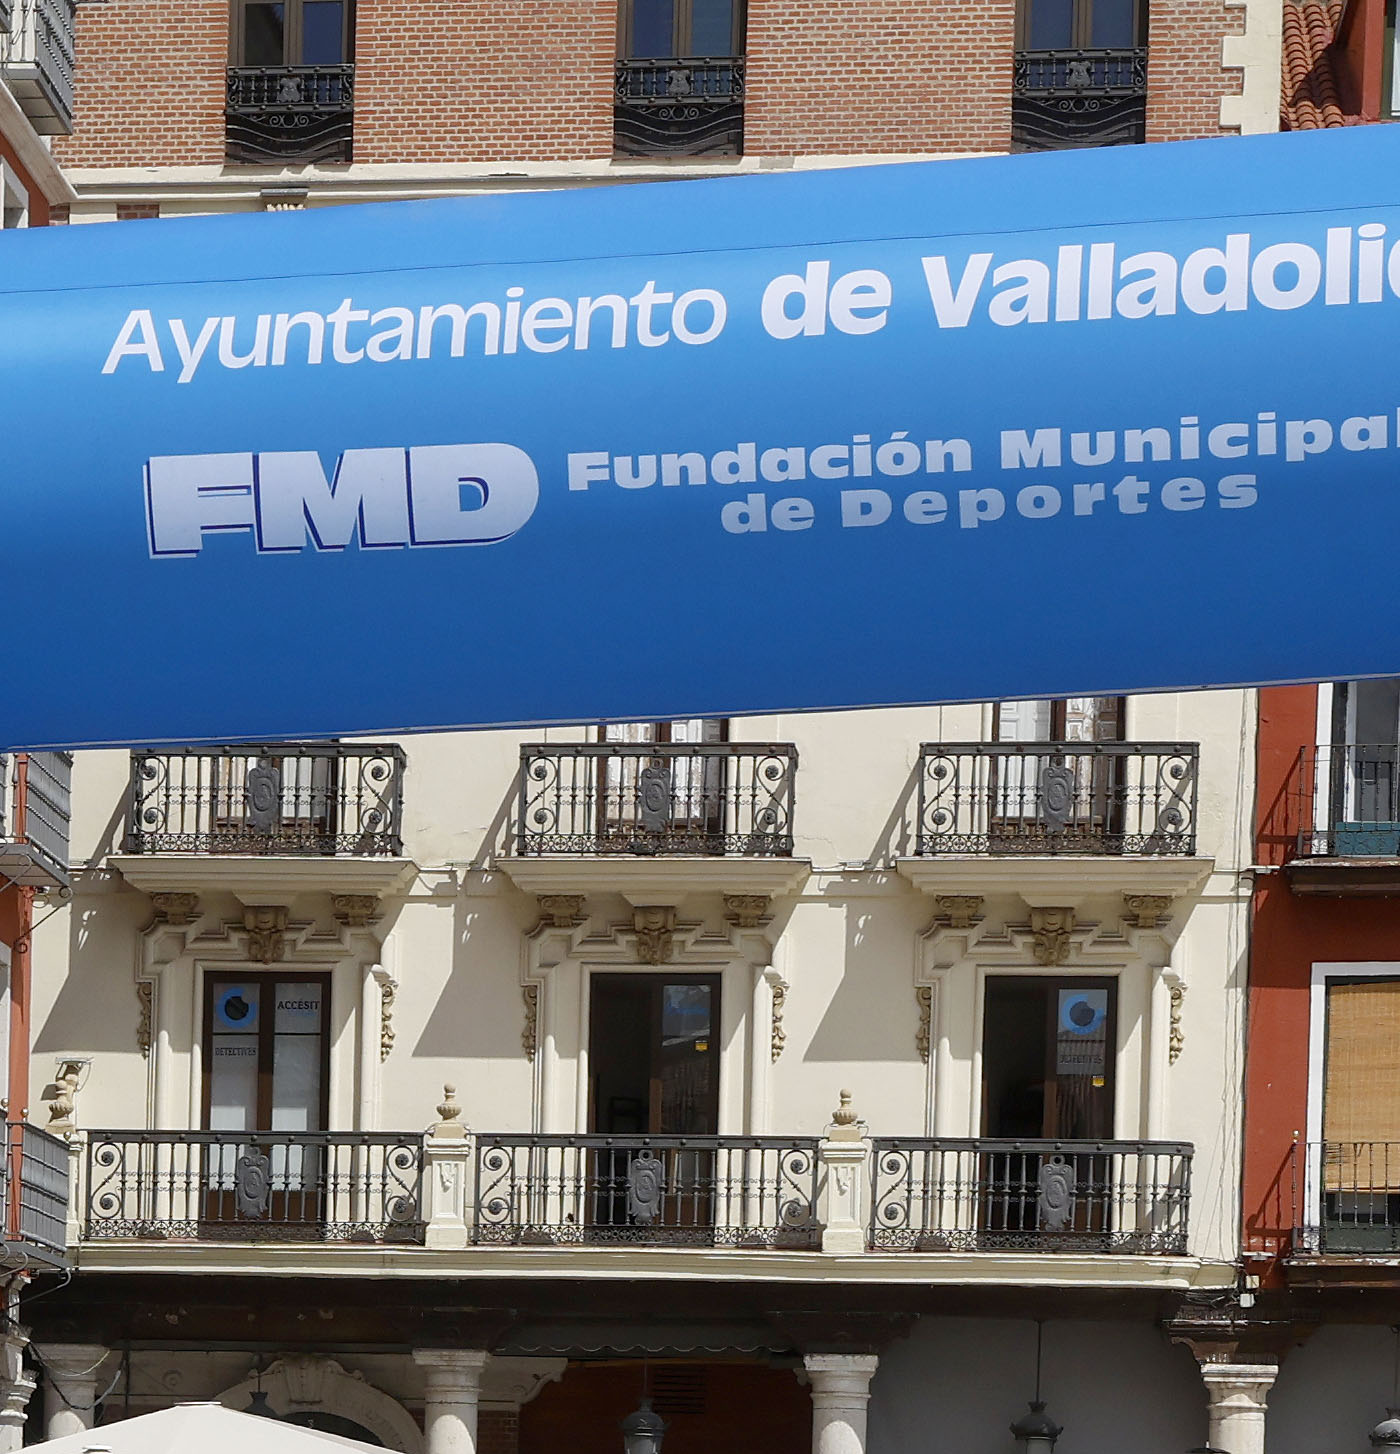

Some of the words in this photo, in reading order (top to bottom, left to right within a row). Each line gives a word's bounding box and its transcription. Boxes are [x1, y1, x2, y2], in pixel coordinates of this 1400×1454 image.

[102, 280, 726, 383] Ayuntamiento
[761, 260, 892, 338] de
[142, 443, 540, 559] FMD
[567, 431, 971, 492] Fundación
[720, 484, 815, 536] de
[841, 466, 1259, 530] Deportes
